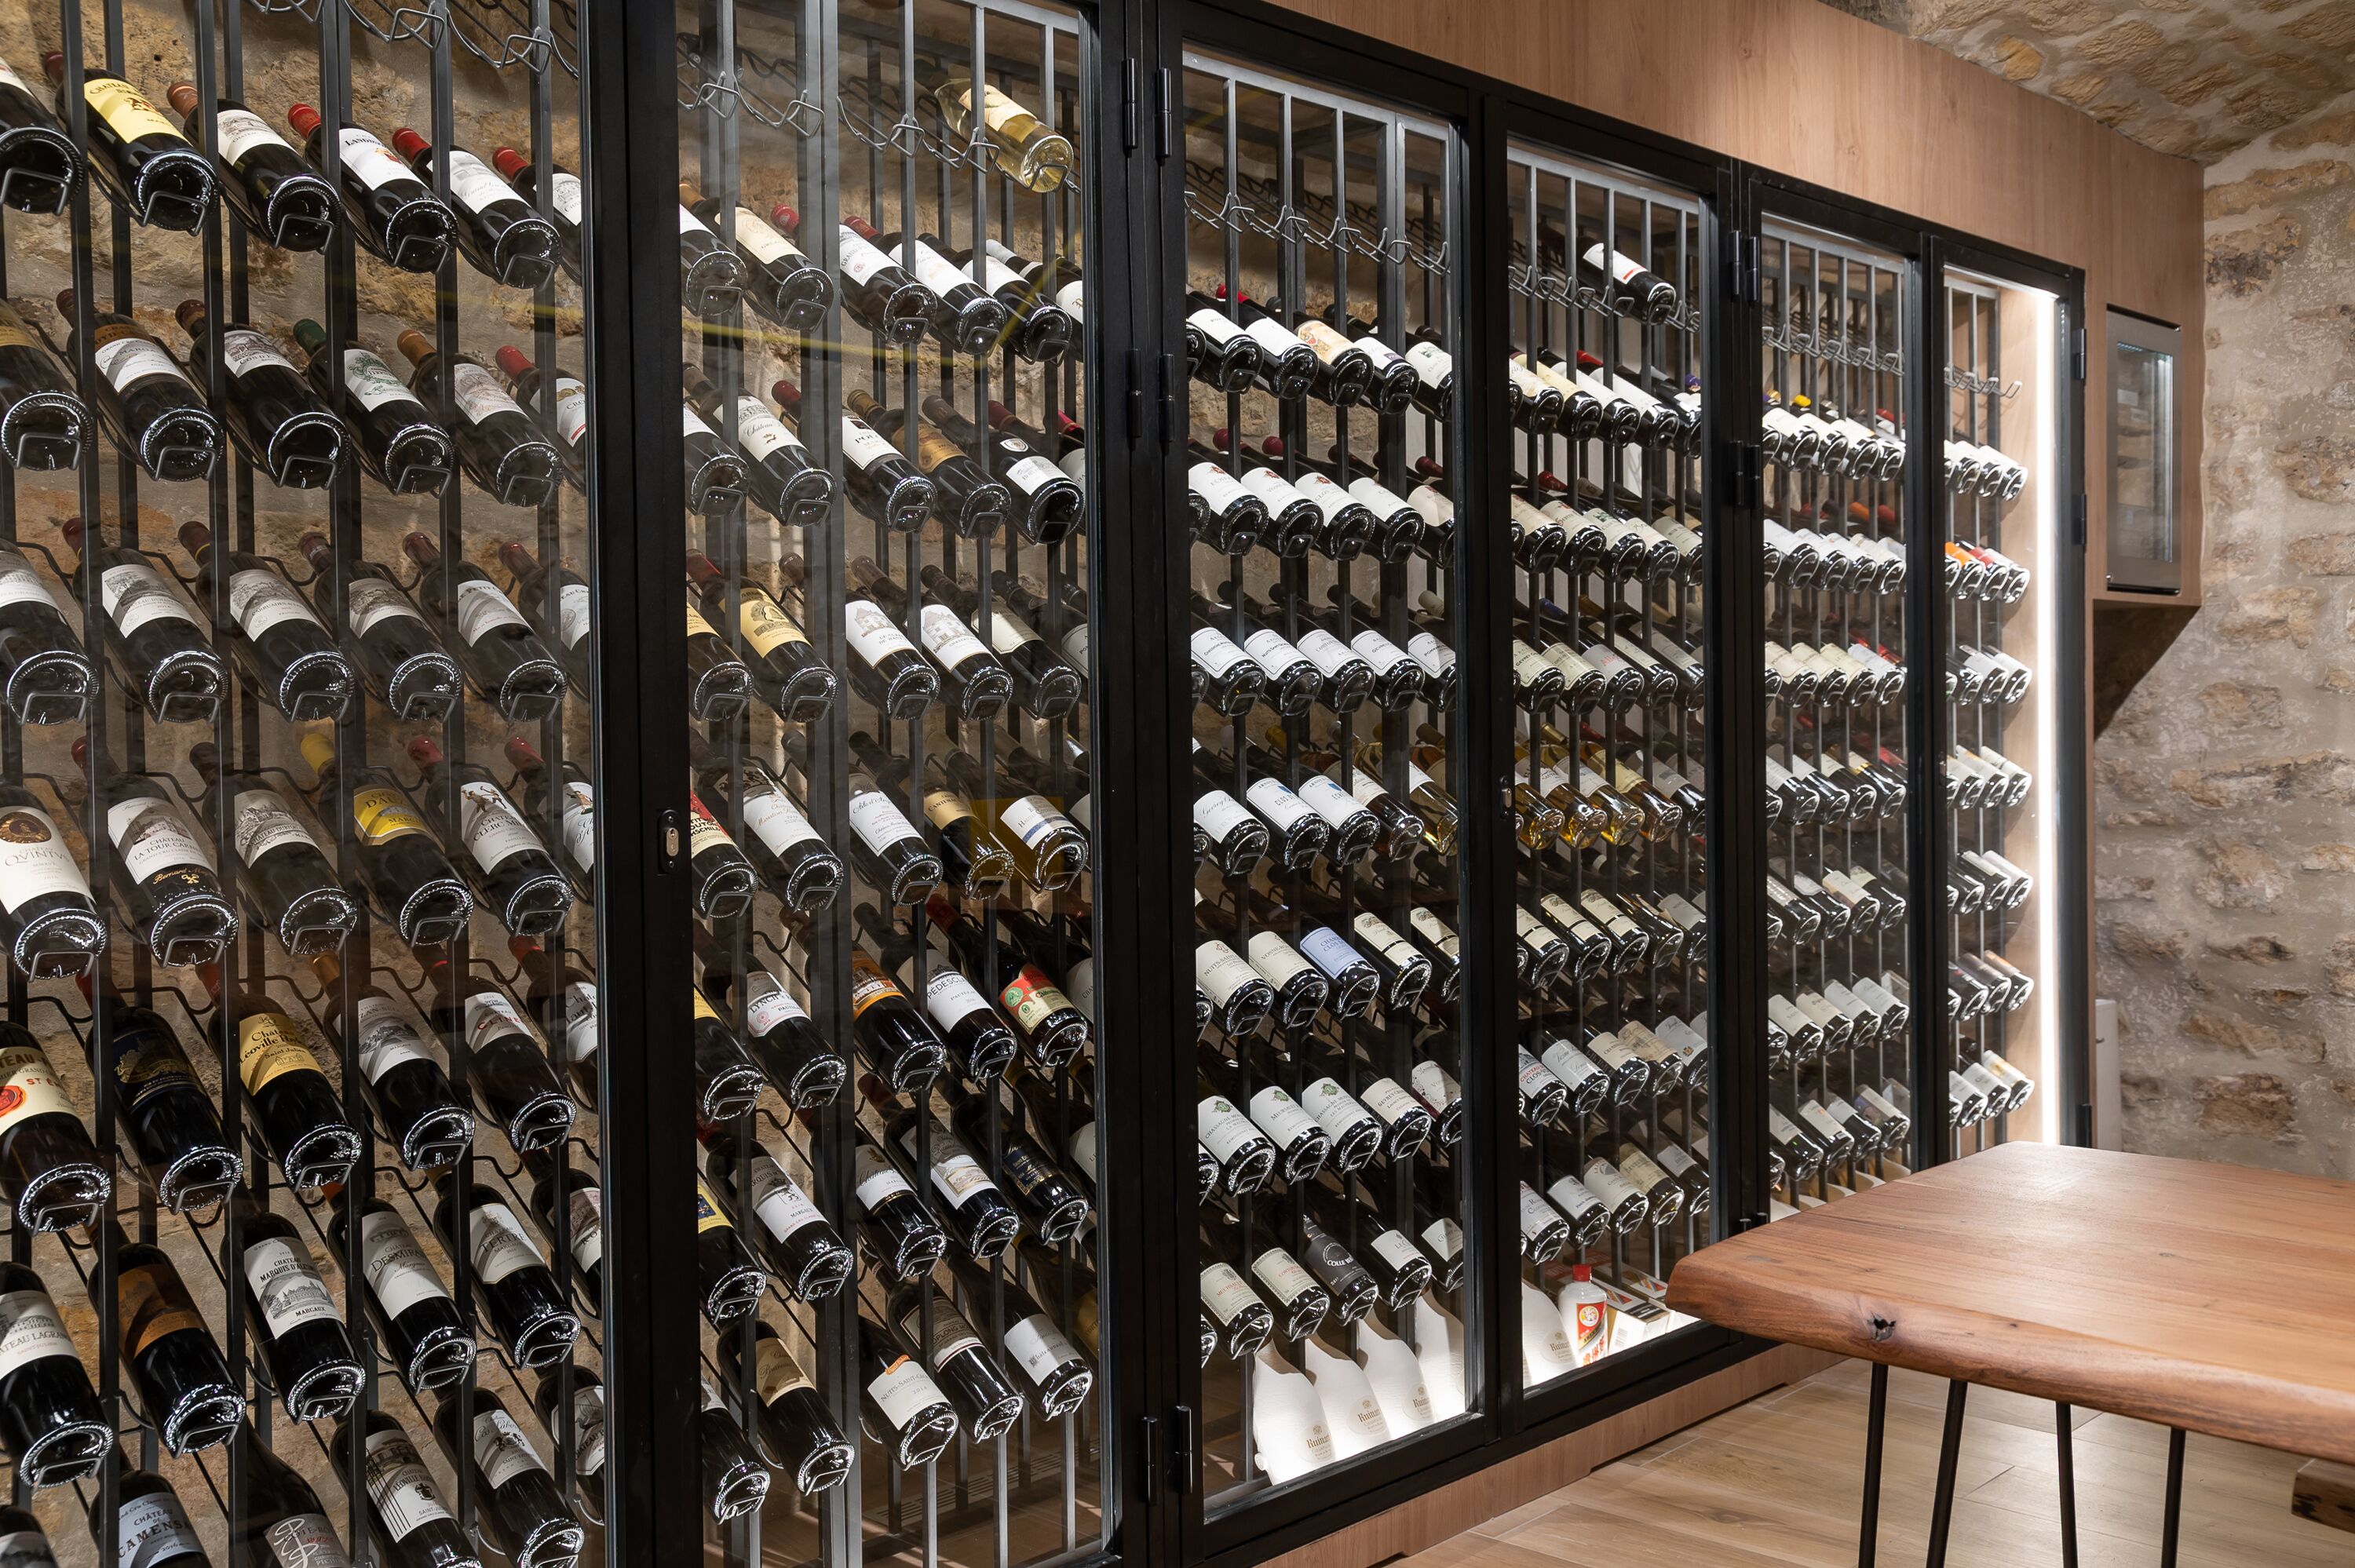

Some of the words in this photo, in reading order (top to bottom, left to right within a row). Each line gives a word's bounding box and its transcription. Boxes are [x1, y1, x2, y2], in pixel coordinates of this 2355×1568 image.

[750, 994, 778, 1014] LYNCH
[480, 1231, 524, 1253] TERTRE
[274, 1257, 301, 1267] CHATEAU
[1327, 1258, 1345, 1267] COLLE
[260, 1264, 290, 1282] MARQUIS
[295, 1306, 327, 1316] MARGAUX
[1306, 1435, 1331, 1449] Ruinart
